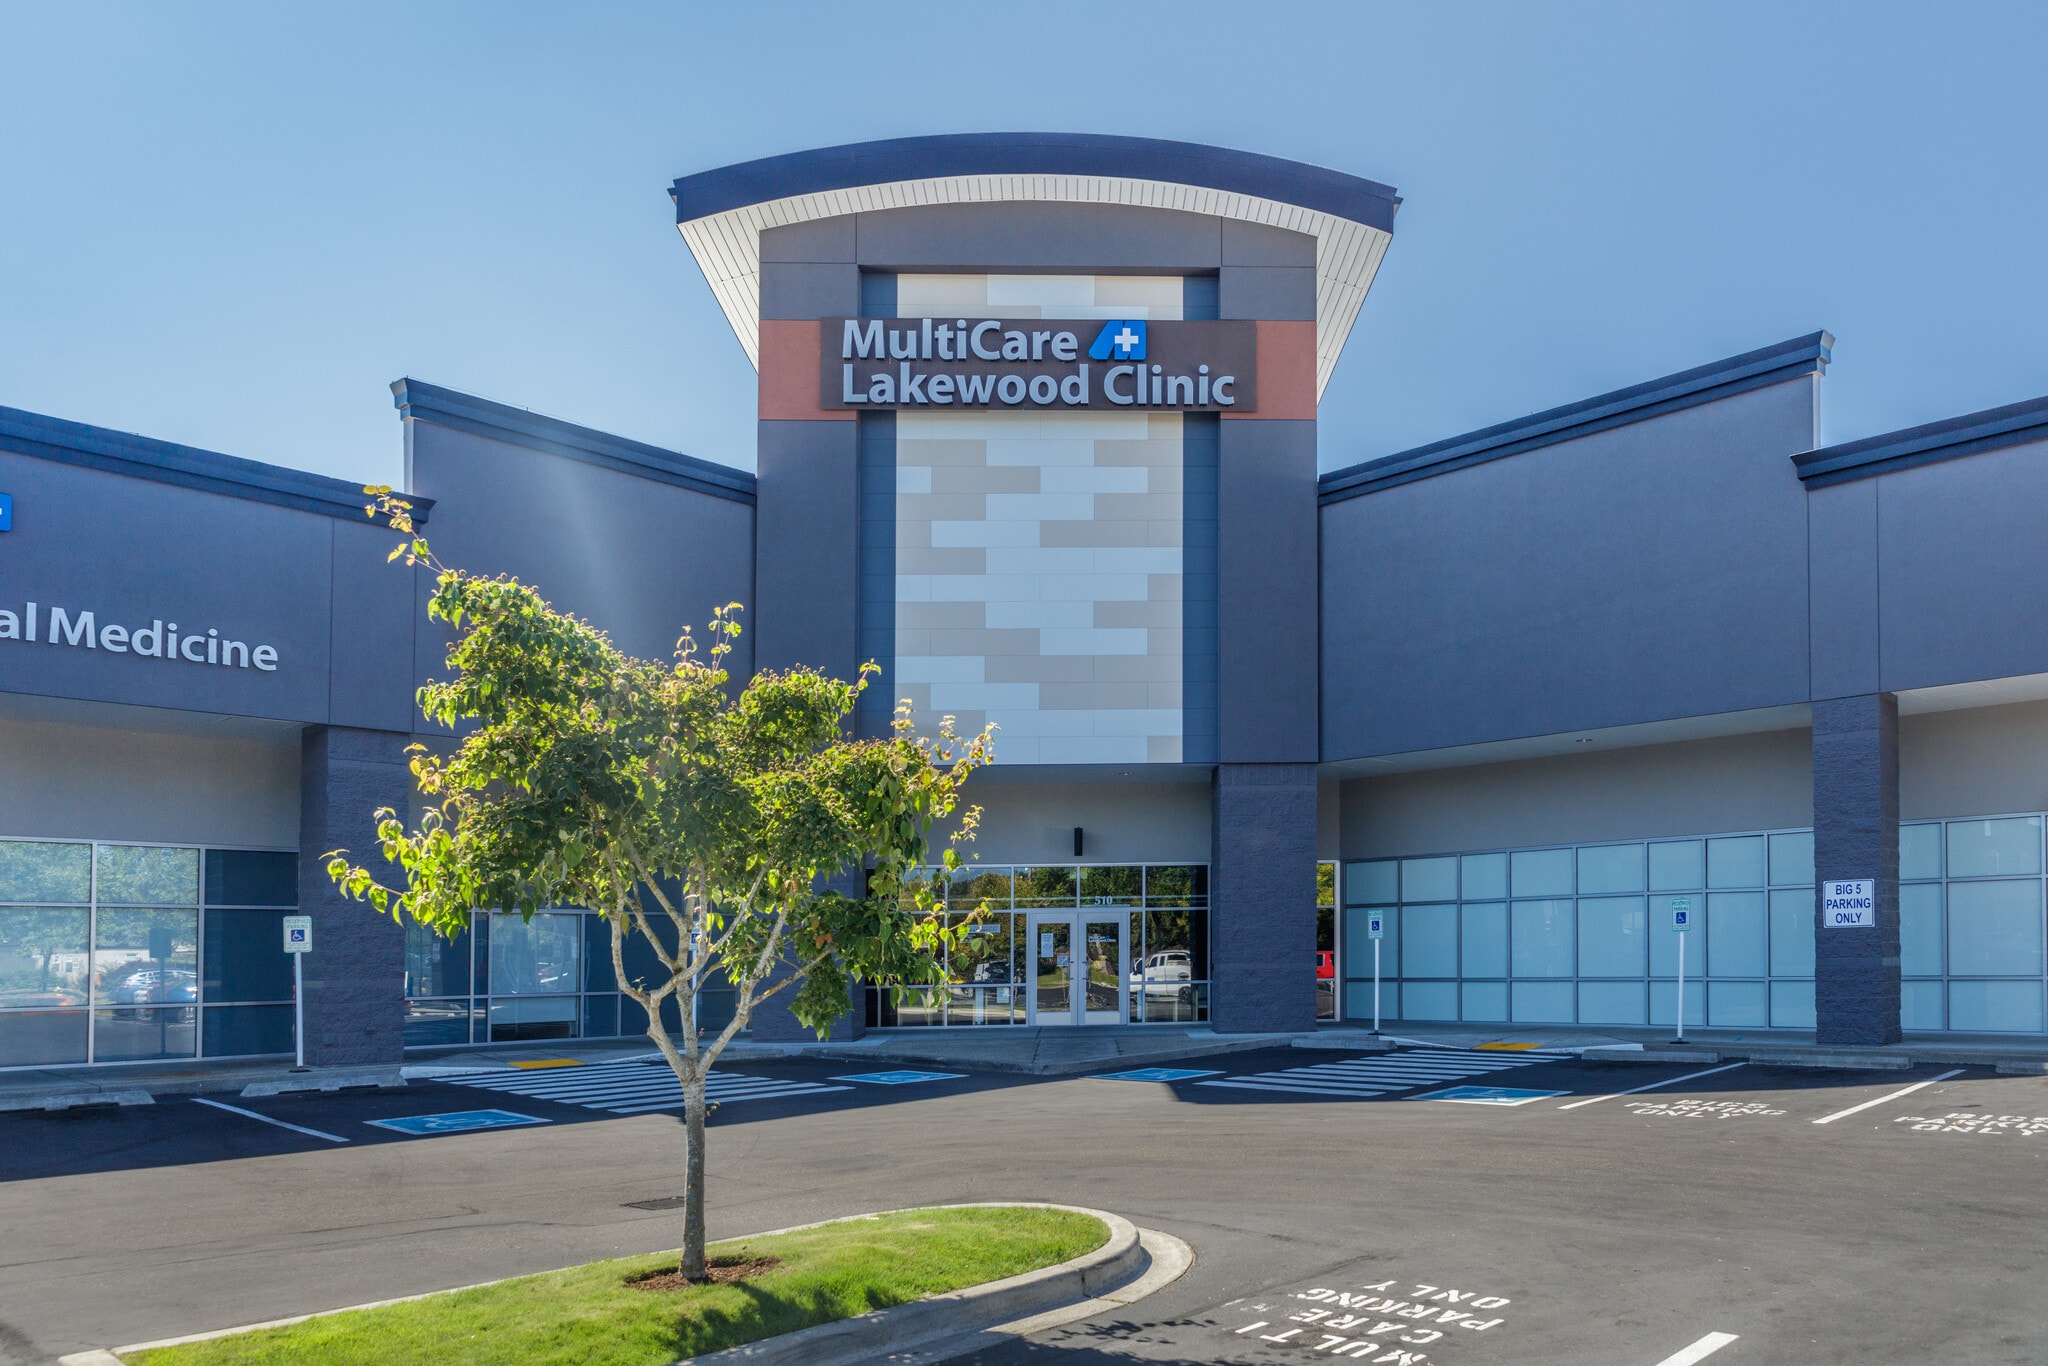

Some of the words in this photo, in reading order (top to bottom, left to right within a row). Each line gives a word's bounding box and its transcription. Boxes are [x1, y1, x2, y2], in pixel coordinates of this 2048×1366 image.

[842, 318, 1078, 361] MultiCare
[843, 362, 1090, 406] Lakewood
[1104, 364, 1235, 406] Clinic
[48, 606, 279, 671] Medicine
[1836, 884, 1853, 894] BIG
[1855, 884, 1862, 894] 5
[1094, 895, 1113, 905] 510
[1826, 897, 1871, 909] PARKING
[1835, 913, 1862, 923] ONLY
[1632, 1108, 1742, 1119] ONLY
[1911, 1123, 2046, 1136] ONLY
[1362, 1280, 1511, 1309] ONLY
[1297, 1288, 1504, 1330] PARKING
[1289, 1308, 1443, 1343] CARE
